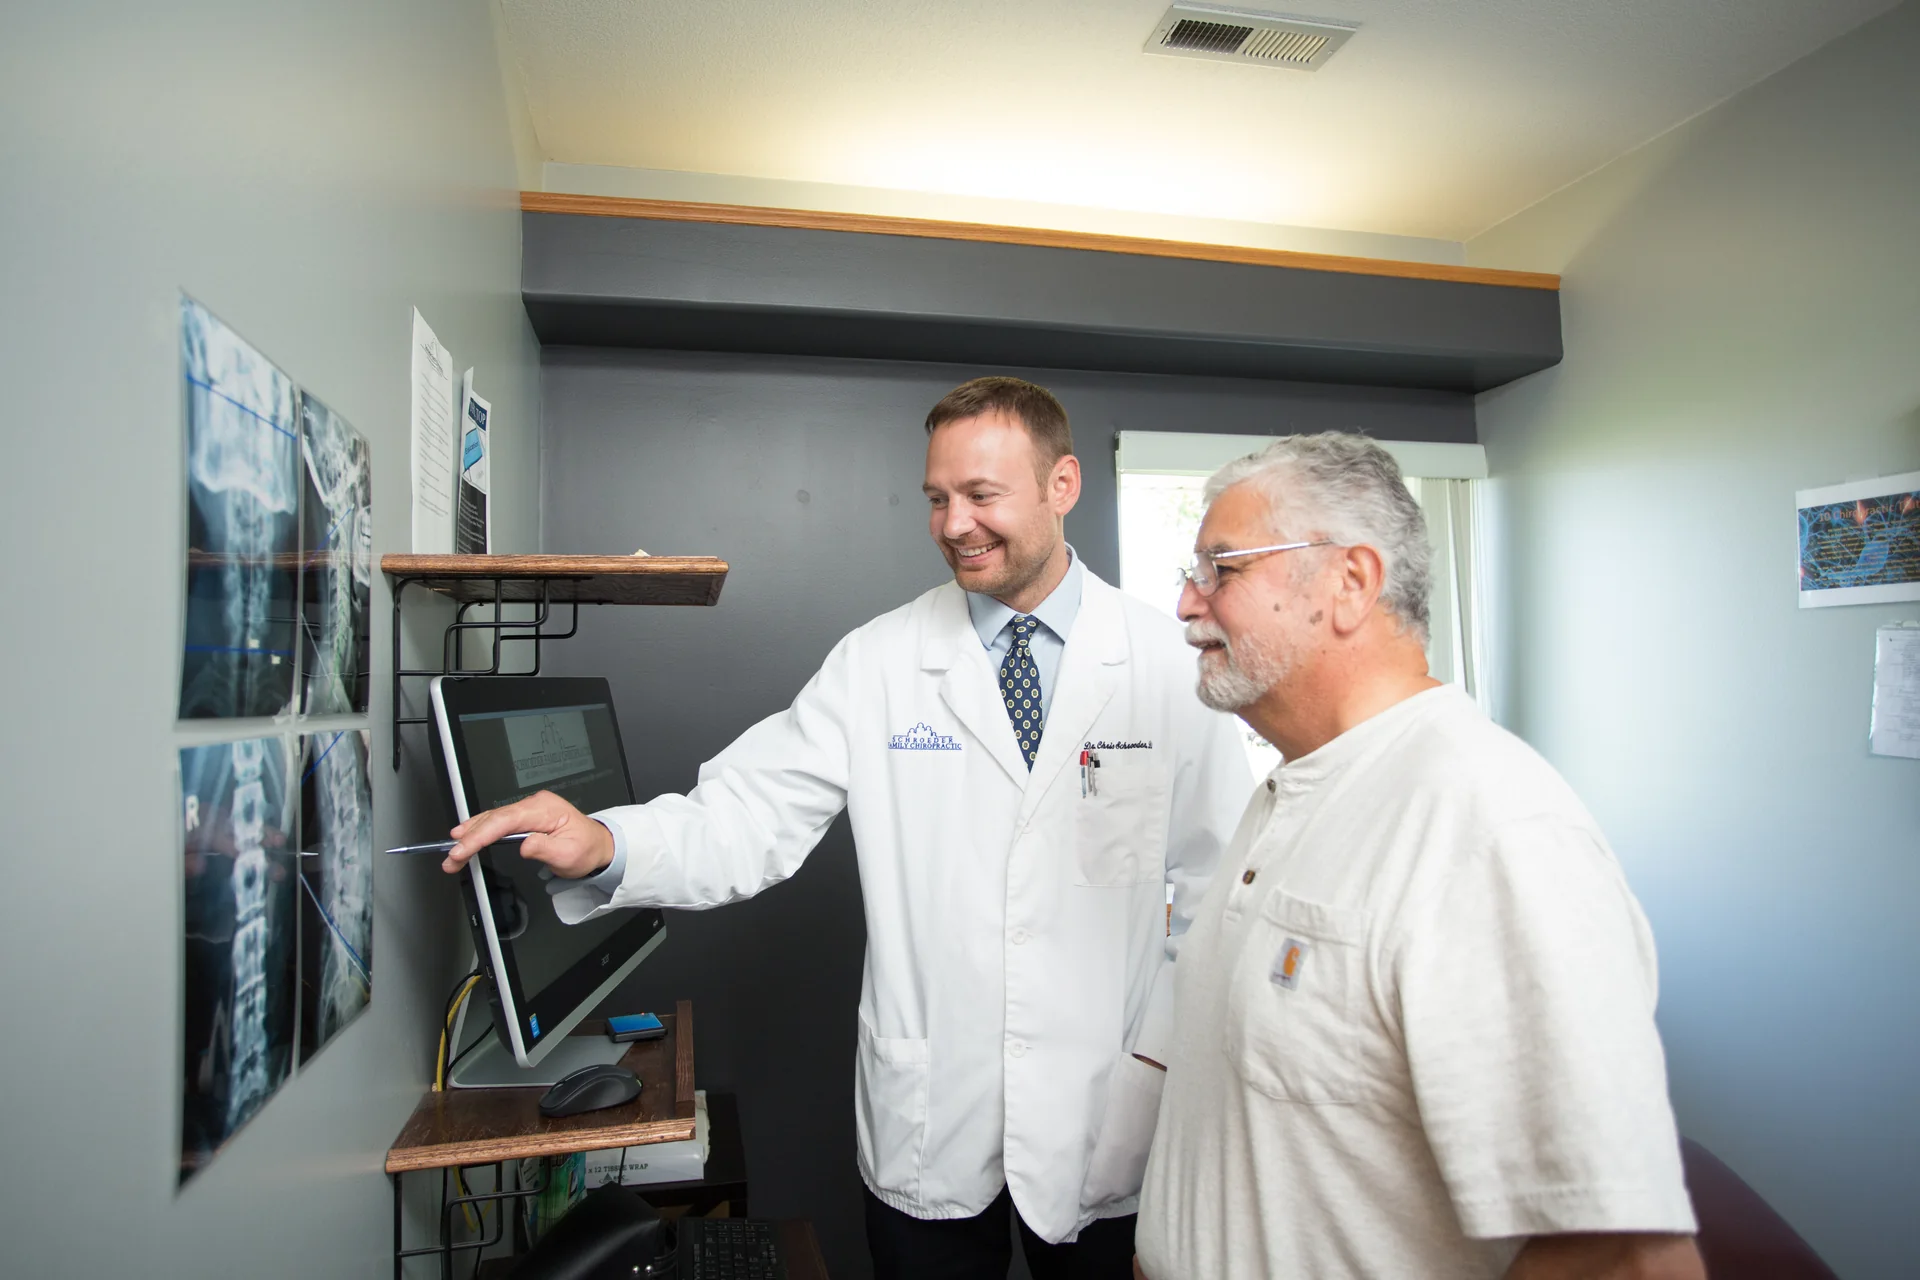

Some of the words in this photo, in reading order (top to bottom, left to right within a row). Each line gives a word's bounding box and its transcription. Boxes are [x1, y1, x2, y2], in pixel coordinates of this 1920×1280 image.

[909, 742, 962, 750] CHIROPRACTIC
[1097, 740, 1115, 750] Chris
[186, 795, 200, 832] R
[603, 1164, 628, 1172] TISSE
[628, 1163, 649, 1171] WRAP
